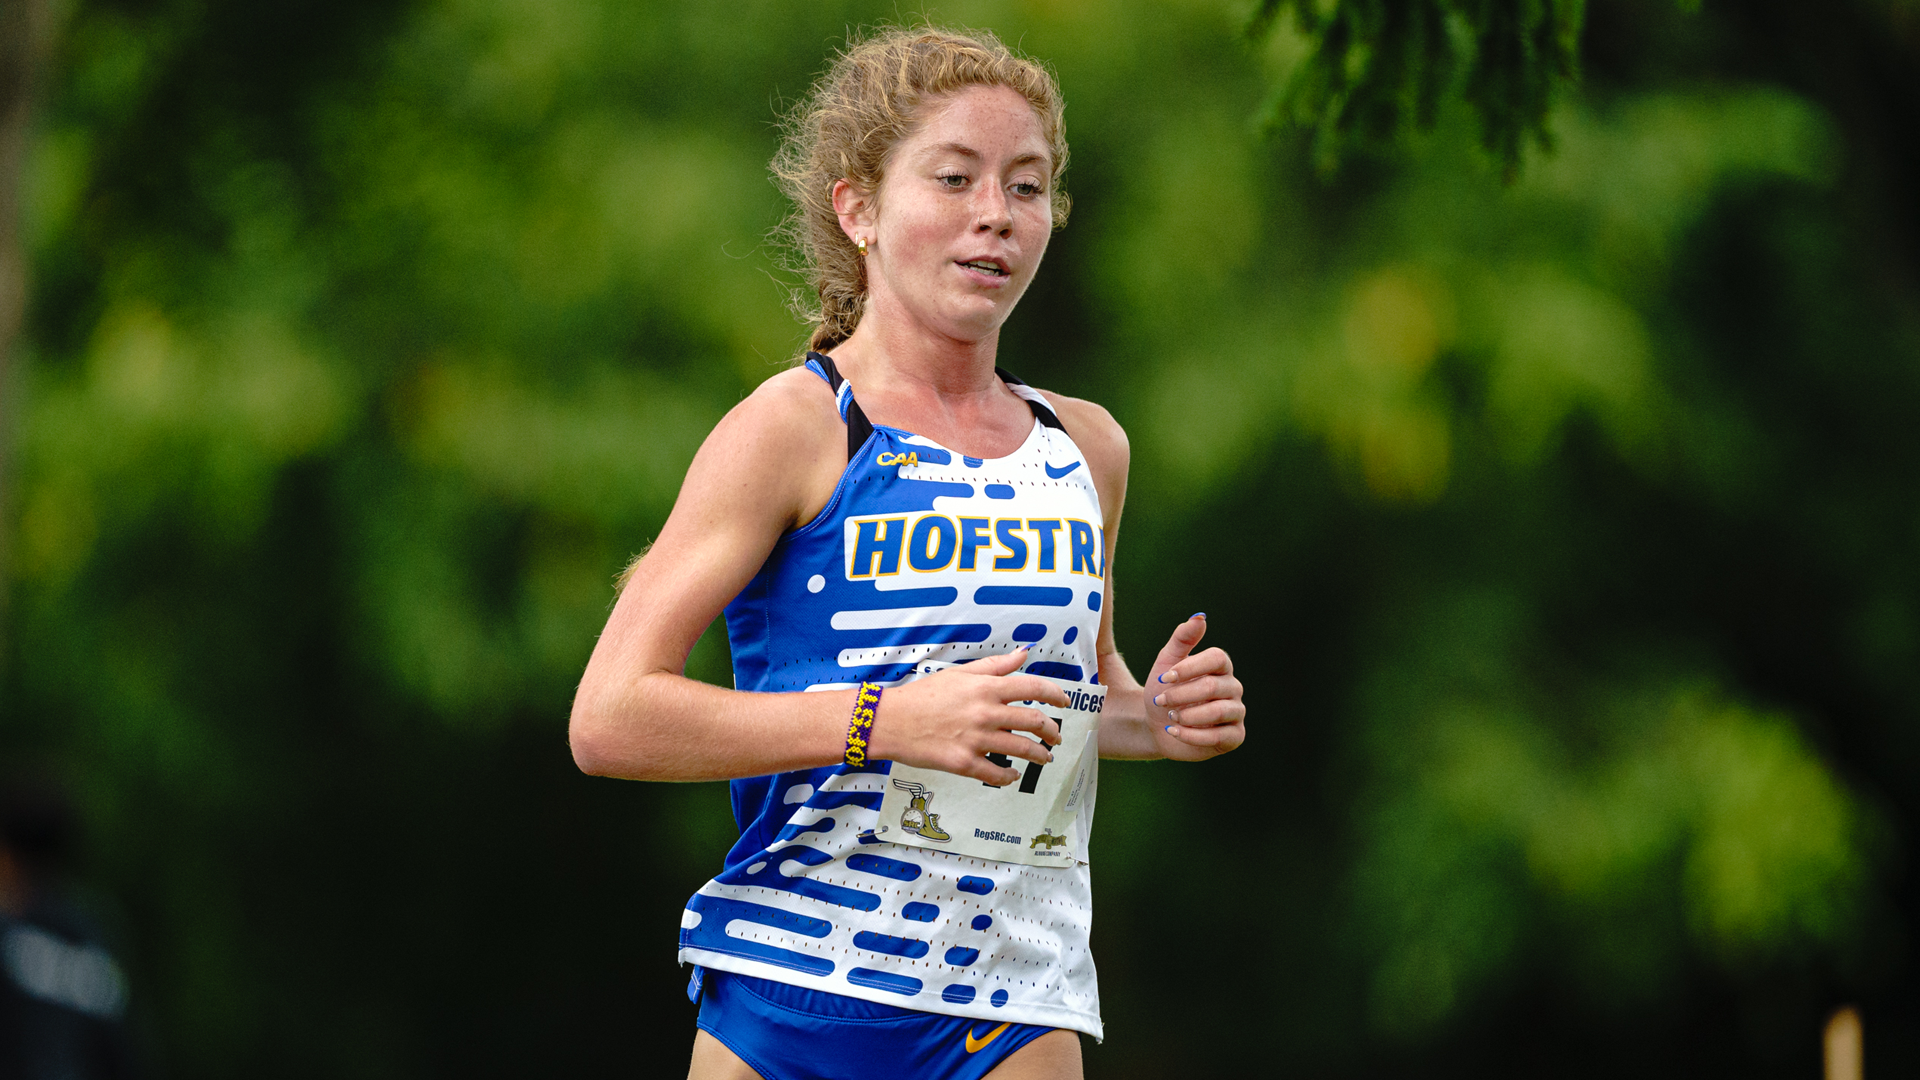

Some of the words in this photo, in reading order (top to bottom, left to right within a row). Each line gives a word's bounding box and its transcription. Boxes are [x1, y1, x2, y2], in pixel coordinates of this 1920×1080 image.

[876, 451, 918, 468] CAA
[850, 513, 1105, 581] HOFSTR
[974, 828, 1022, 845] RegSRC.com
